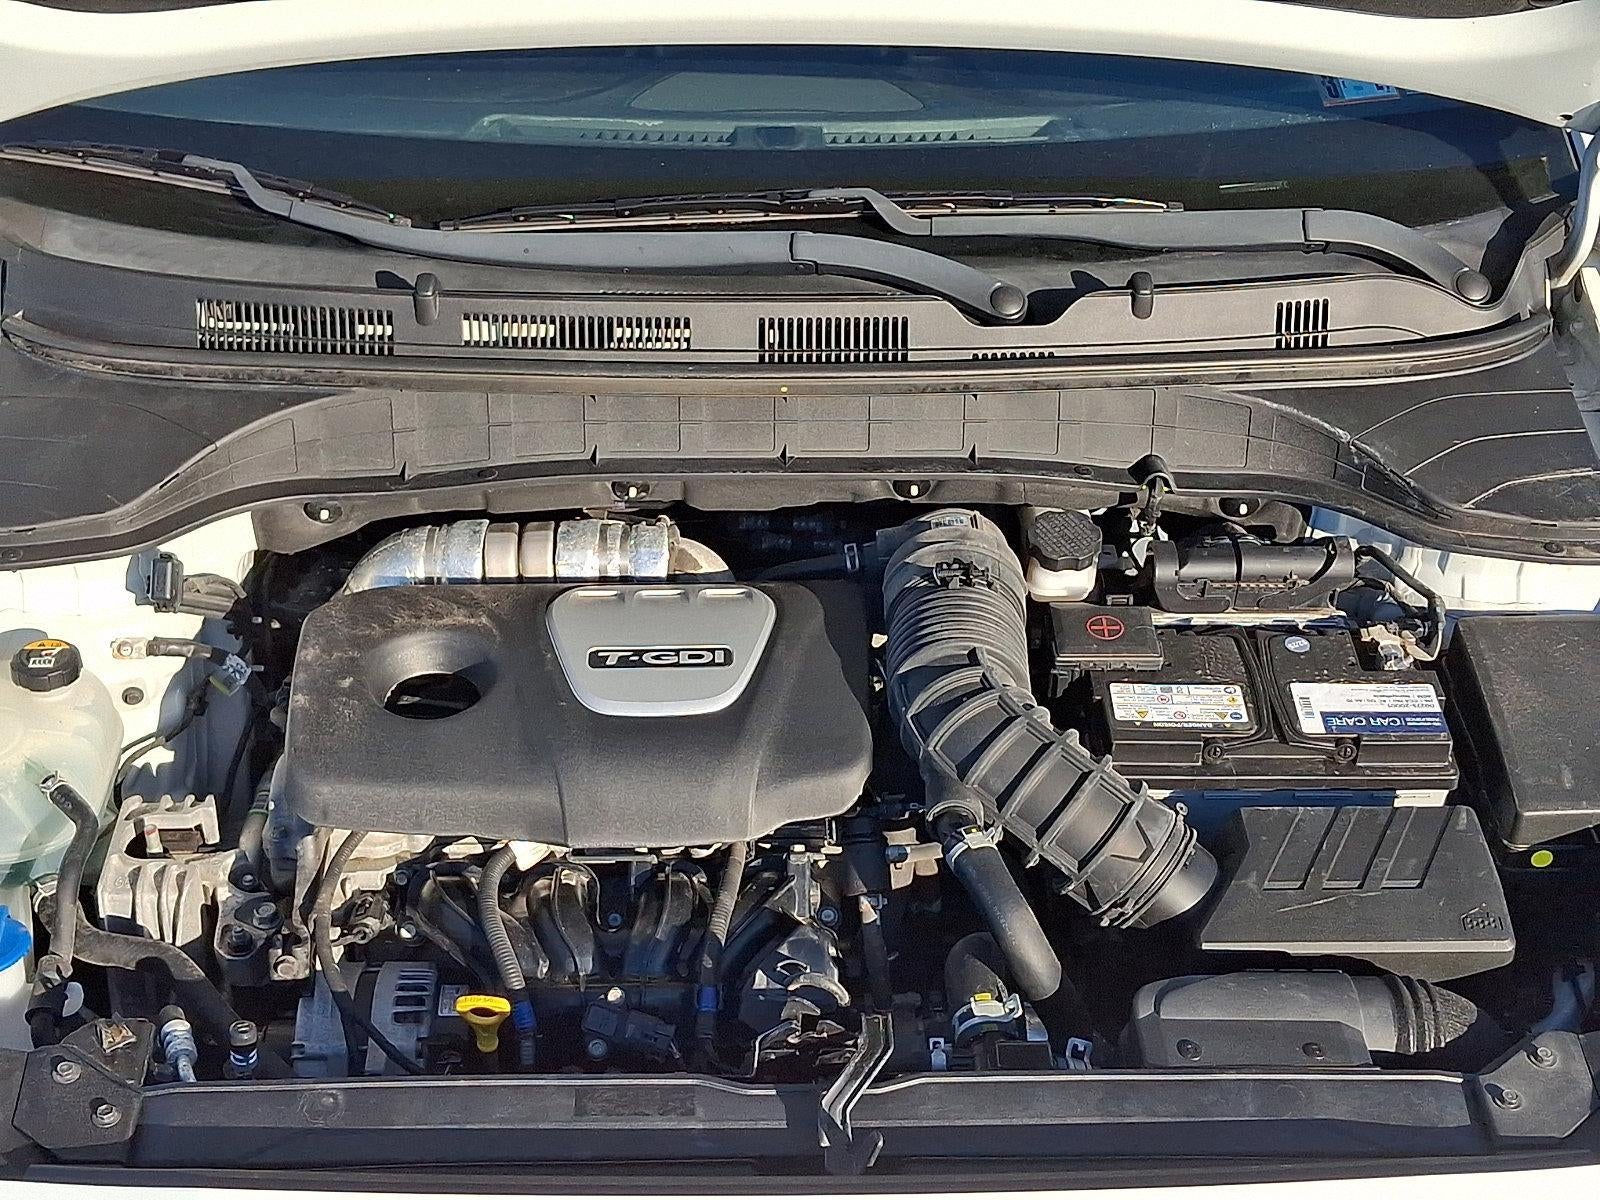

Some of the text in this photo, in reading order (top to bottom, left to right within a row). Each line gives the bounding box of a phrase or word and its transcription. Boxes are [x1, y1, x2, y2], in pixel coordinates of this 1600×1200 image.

[597, 649, 725, 666] T-GDI
[1326, 716, 1402, 726] CAR CARE
